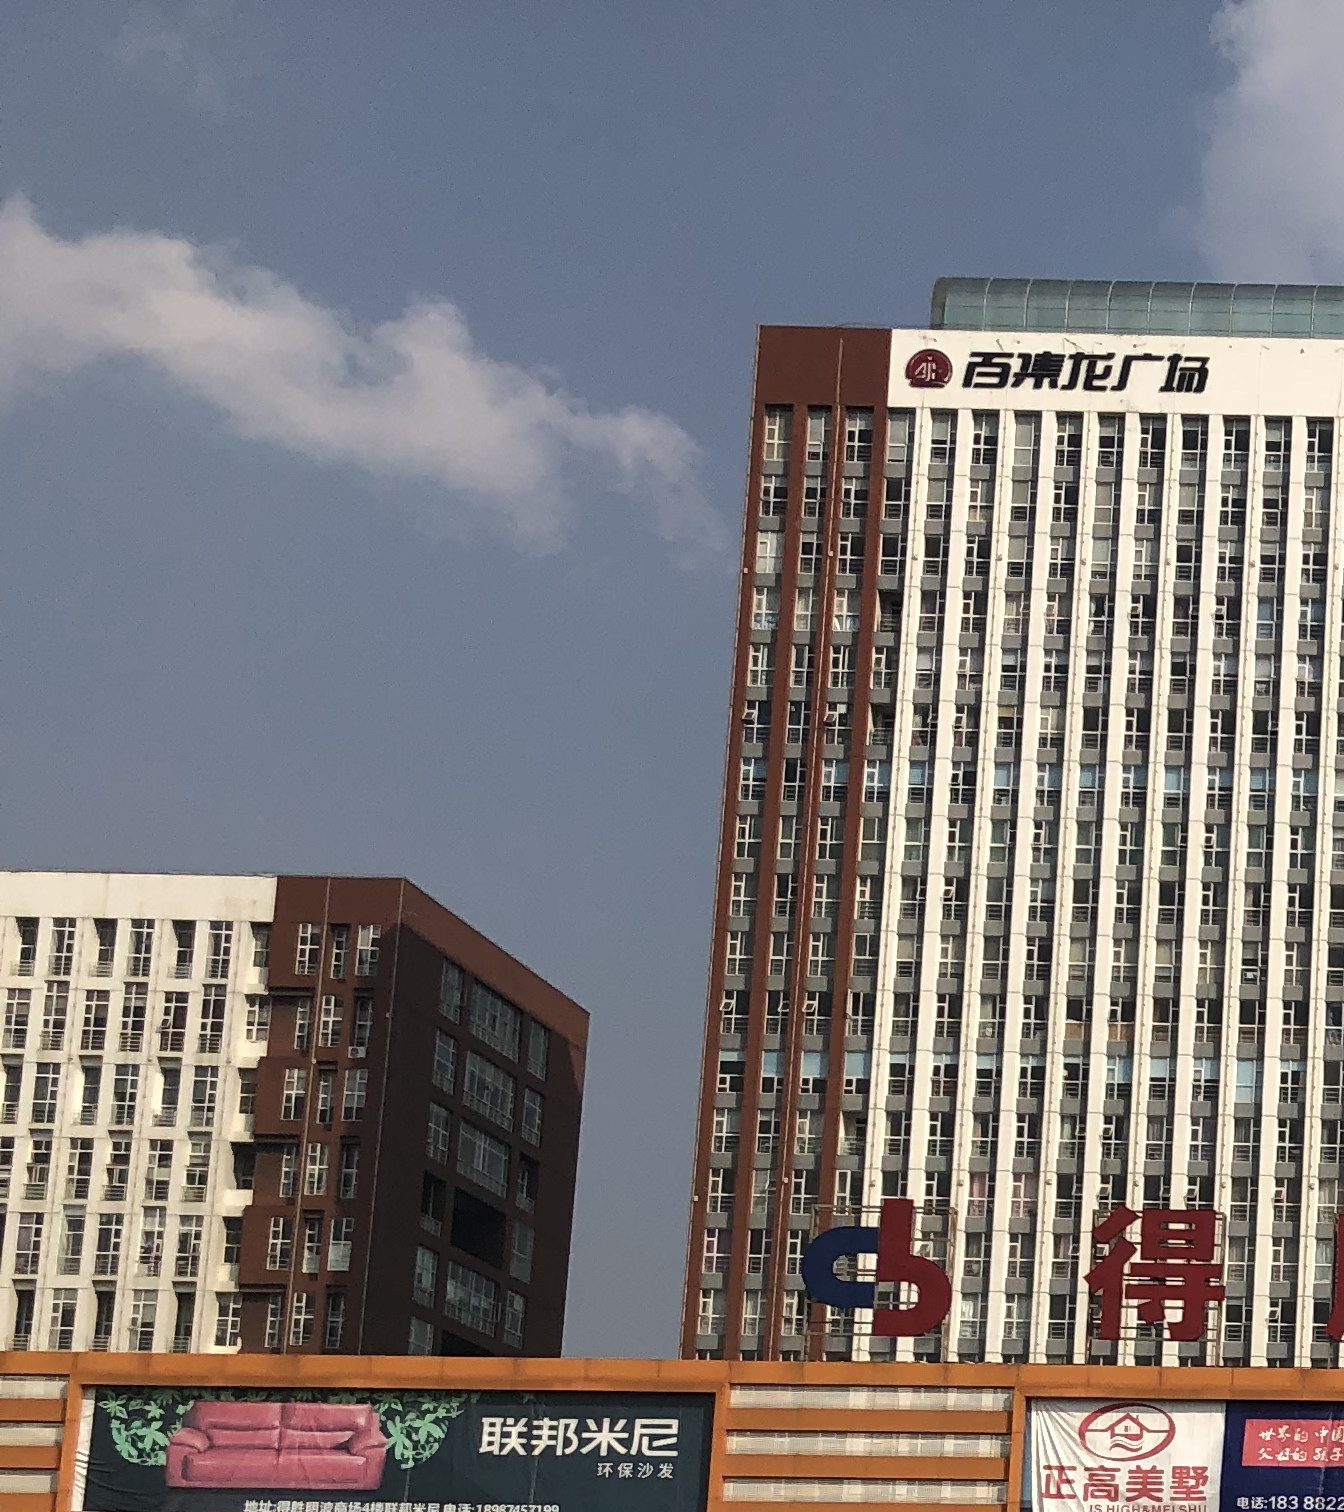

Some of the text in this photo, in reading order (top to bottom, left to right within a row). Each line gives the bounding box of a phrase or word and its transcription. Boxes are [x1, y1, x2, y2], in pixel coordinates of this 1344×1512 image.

[478, 1416, 680, 1457] 联邦米尼
[596, 1462, 675, 1479] 环保沙发
[1041, 1464, 1209, 1503] 正高美墅
